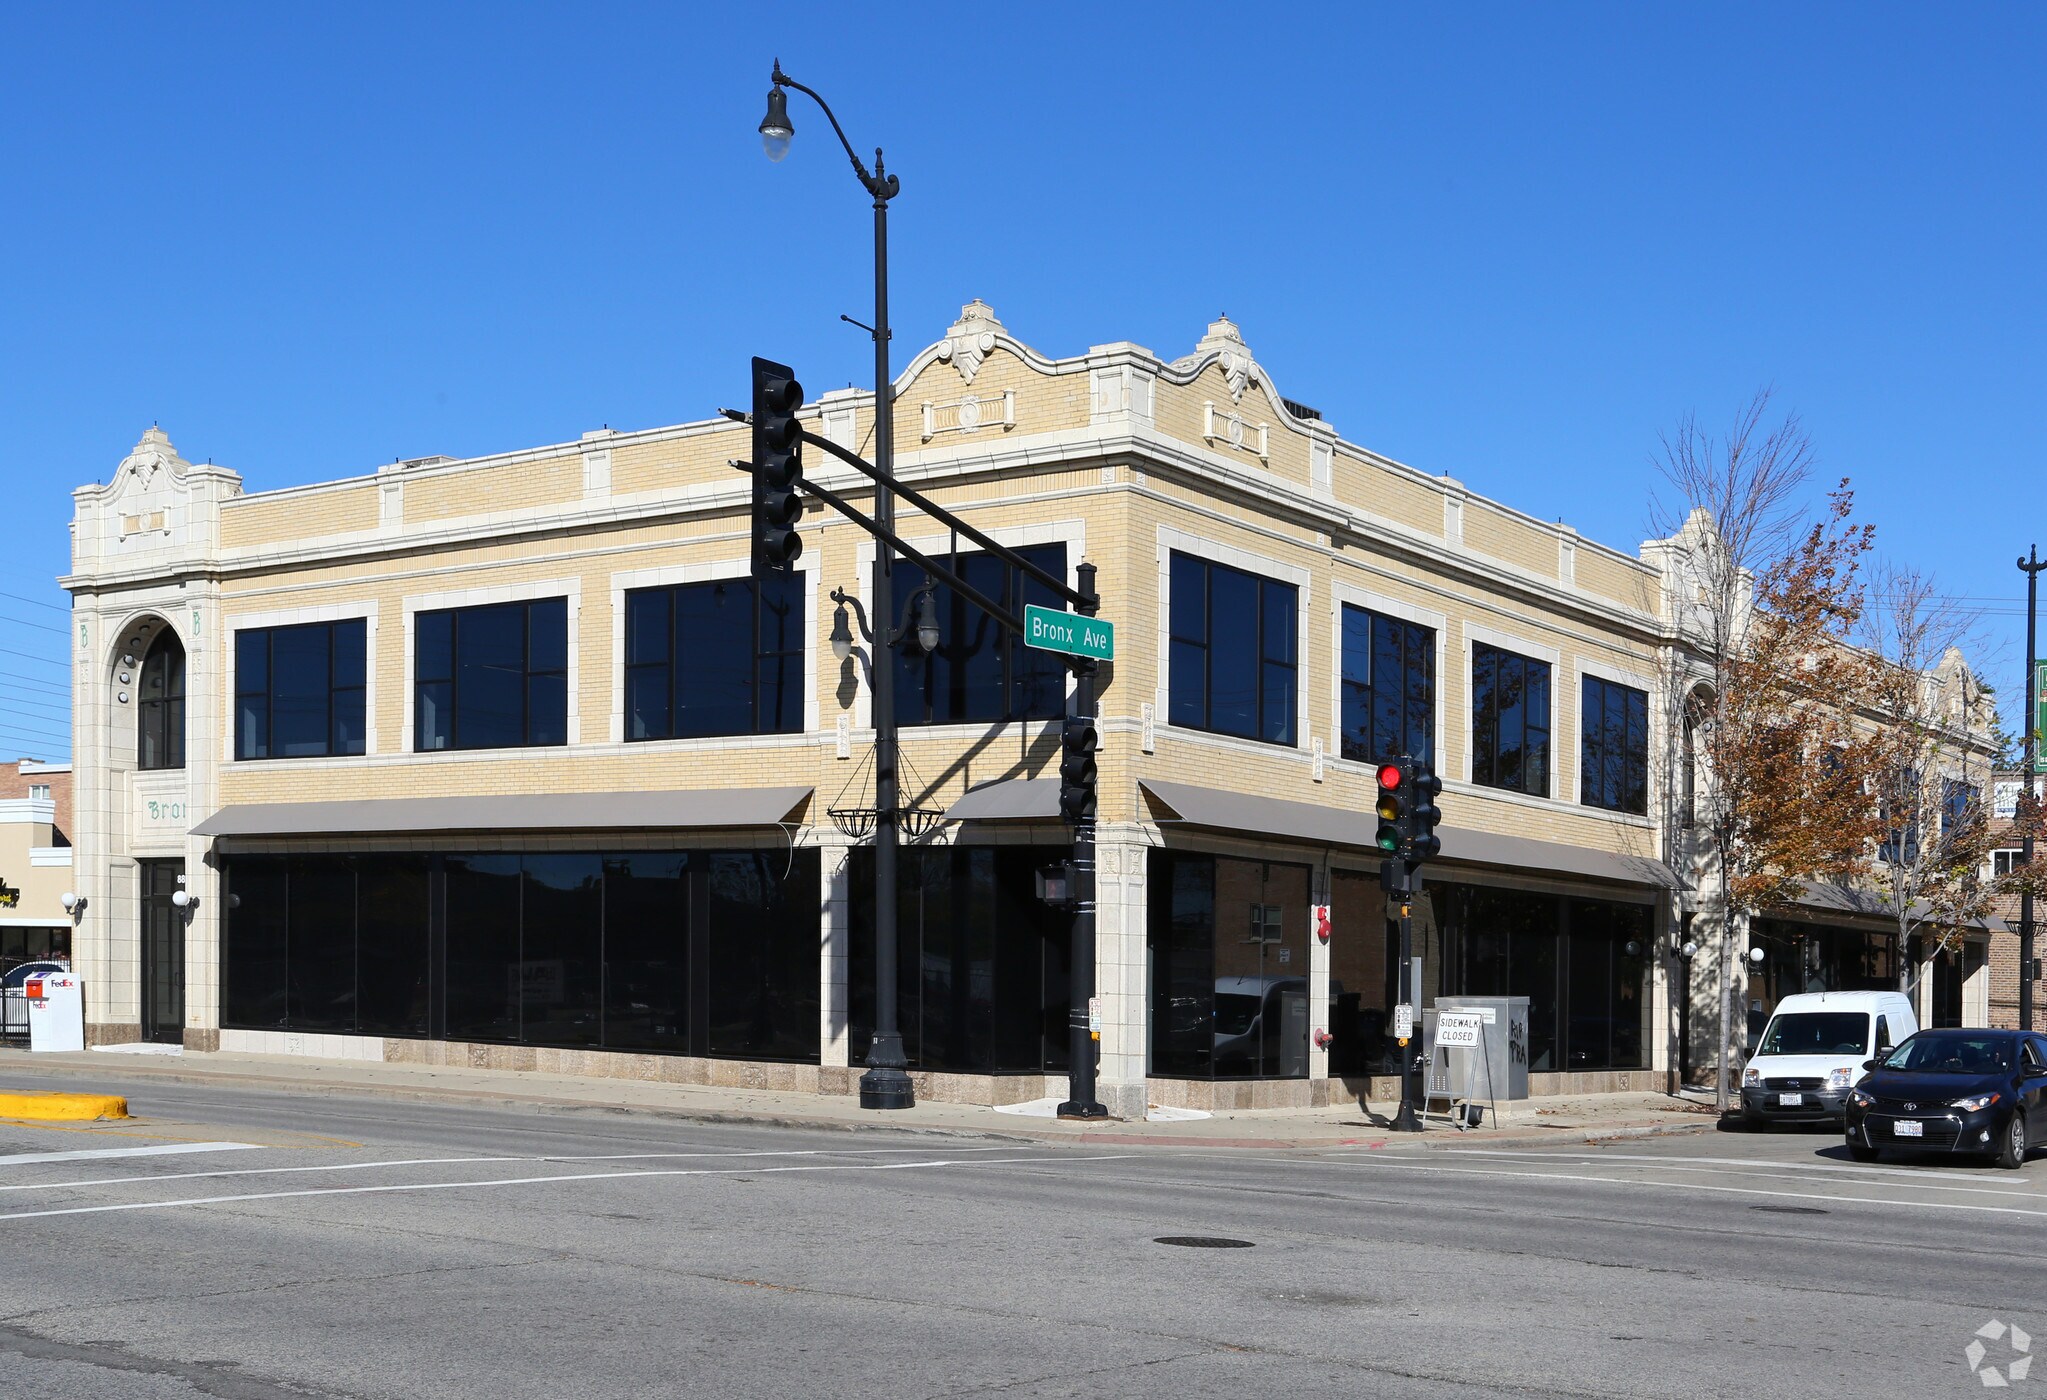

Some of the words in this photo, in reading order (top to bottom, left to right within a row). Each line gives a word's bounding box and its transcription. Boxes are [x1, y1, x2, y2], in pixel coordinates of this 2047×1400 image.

[1033, 617, 1073, 643] Bronx
[1083, 627, 1107, 649] Ave
[51, 979, 74, 987] FedEx
[1440, 1018, 1479, 1029] SIDEWALK
[1442, 1031, 1474, 1041] CLOSED
